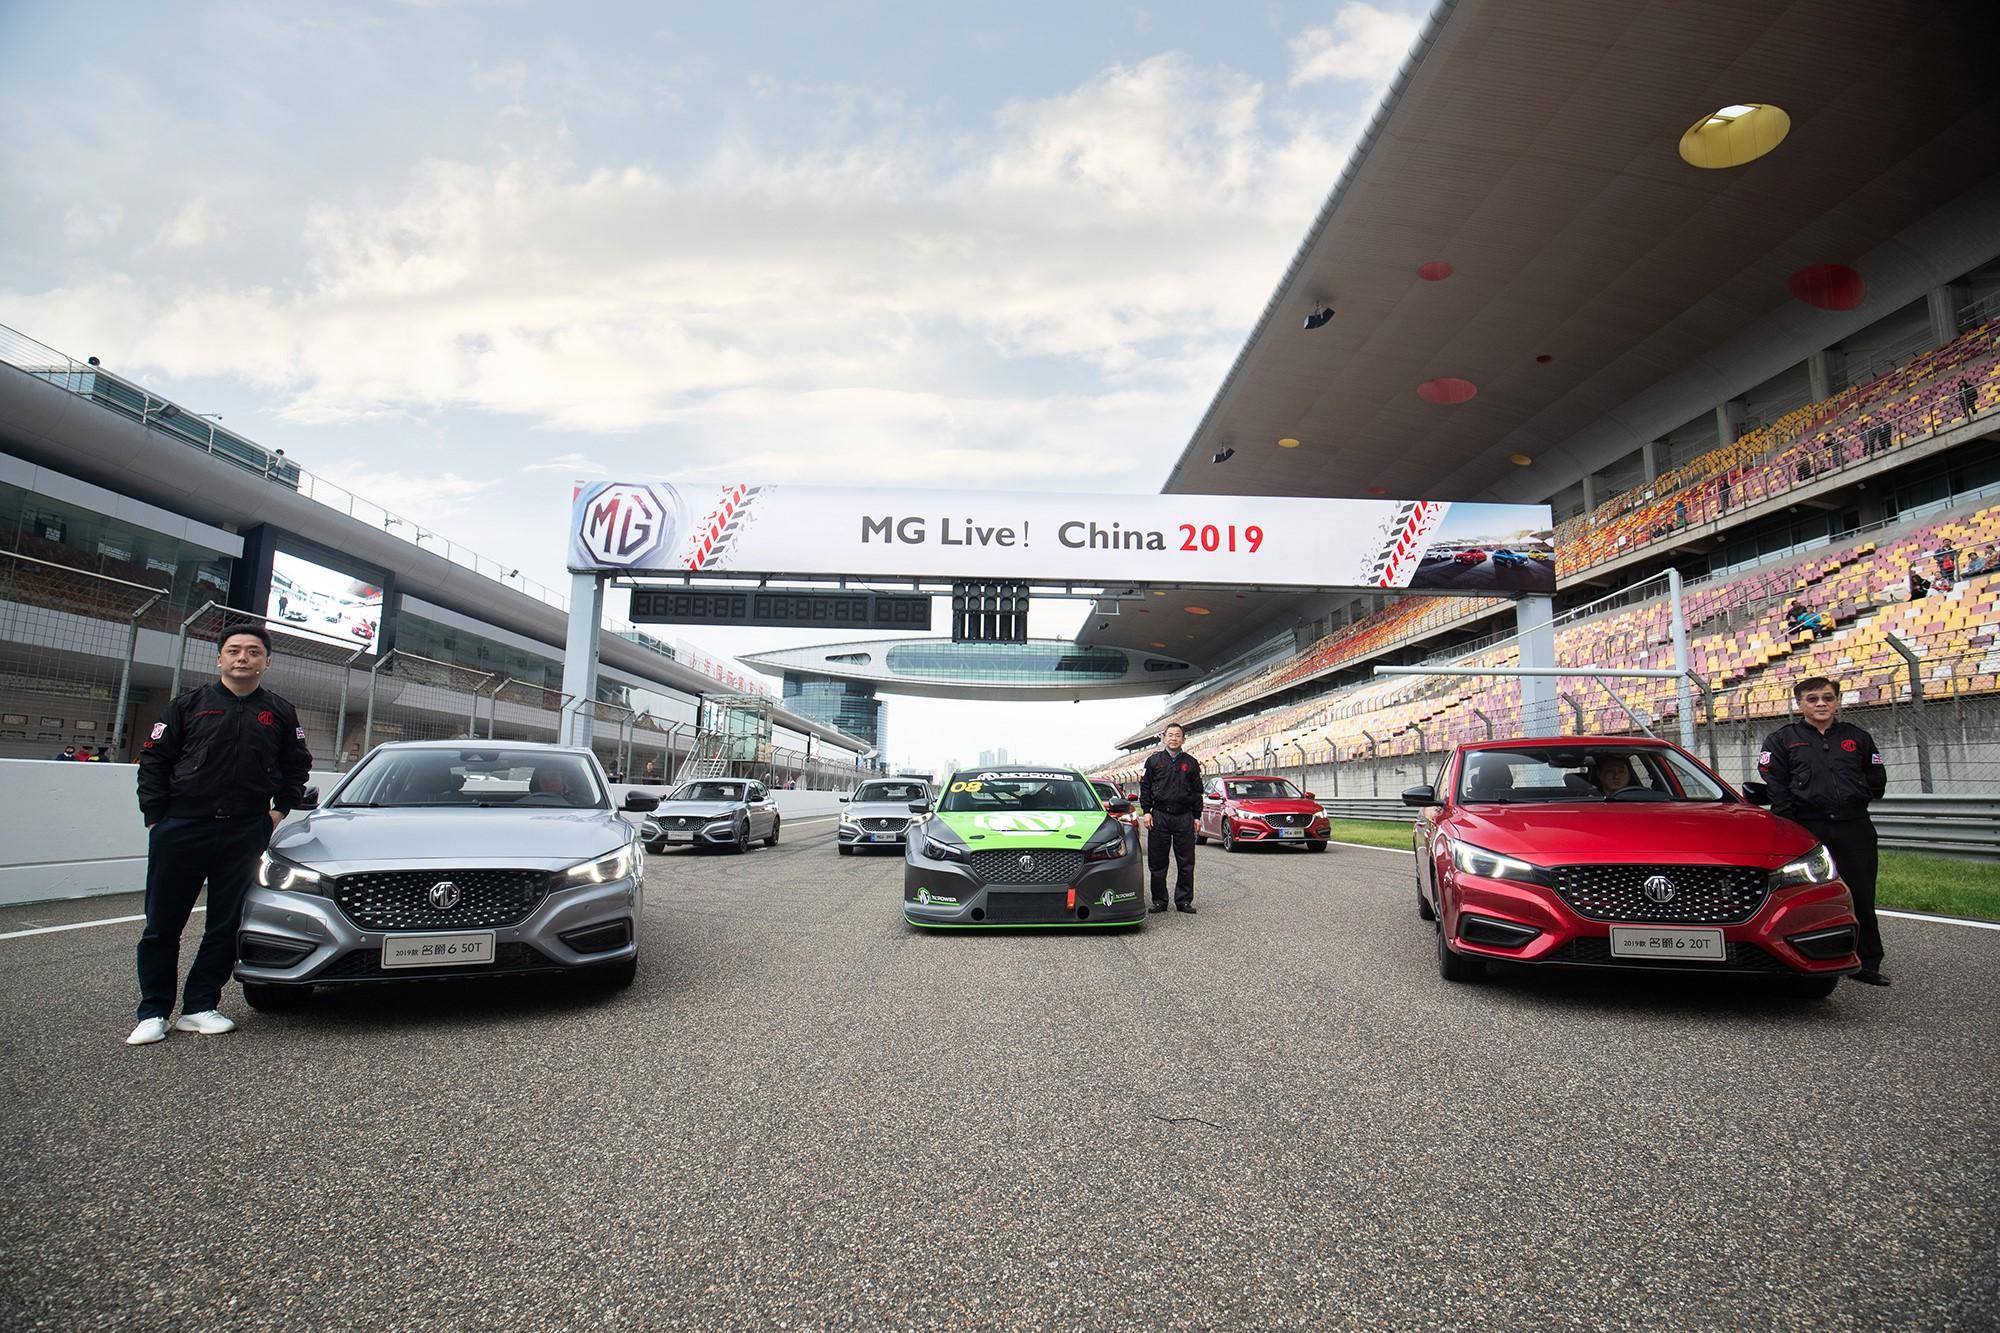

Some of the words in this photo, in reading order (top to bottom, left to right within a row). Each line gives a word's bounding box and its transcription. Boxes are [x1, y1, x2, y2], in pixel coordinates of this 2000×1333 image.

[587, 490, 656, 559] MG
[861, 516, 926, 545] MG
[941, 517, 1029, 548] Live!
[1058, 521, 1167, 551] China
[1178, 523, 1264, 553] 2019
[950, 781, 983, 793] 08
[432, 884, 459, 907] MG
[1646, 877, 1674, 901] MG
[461, 942, 483, 953] 50T
[1689, 938, 1711, 949] 20T
